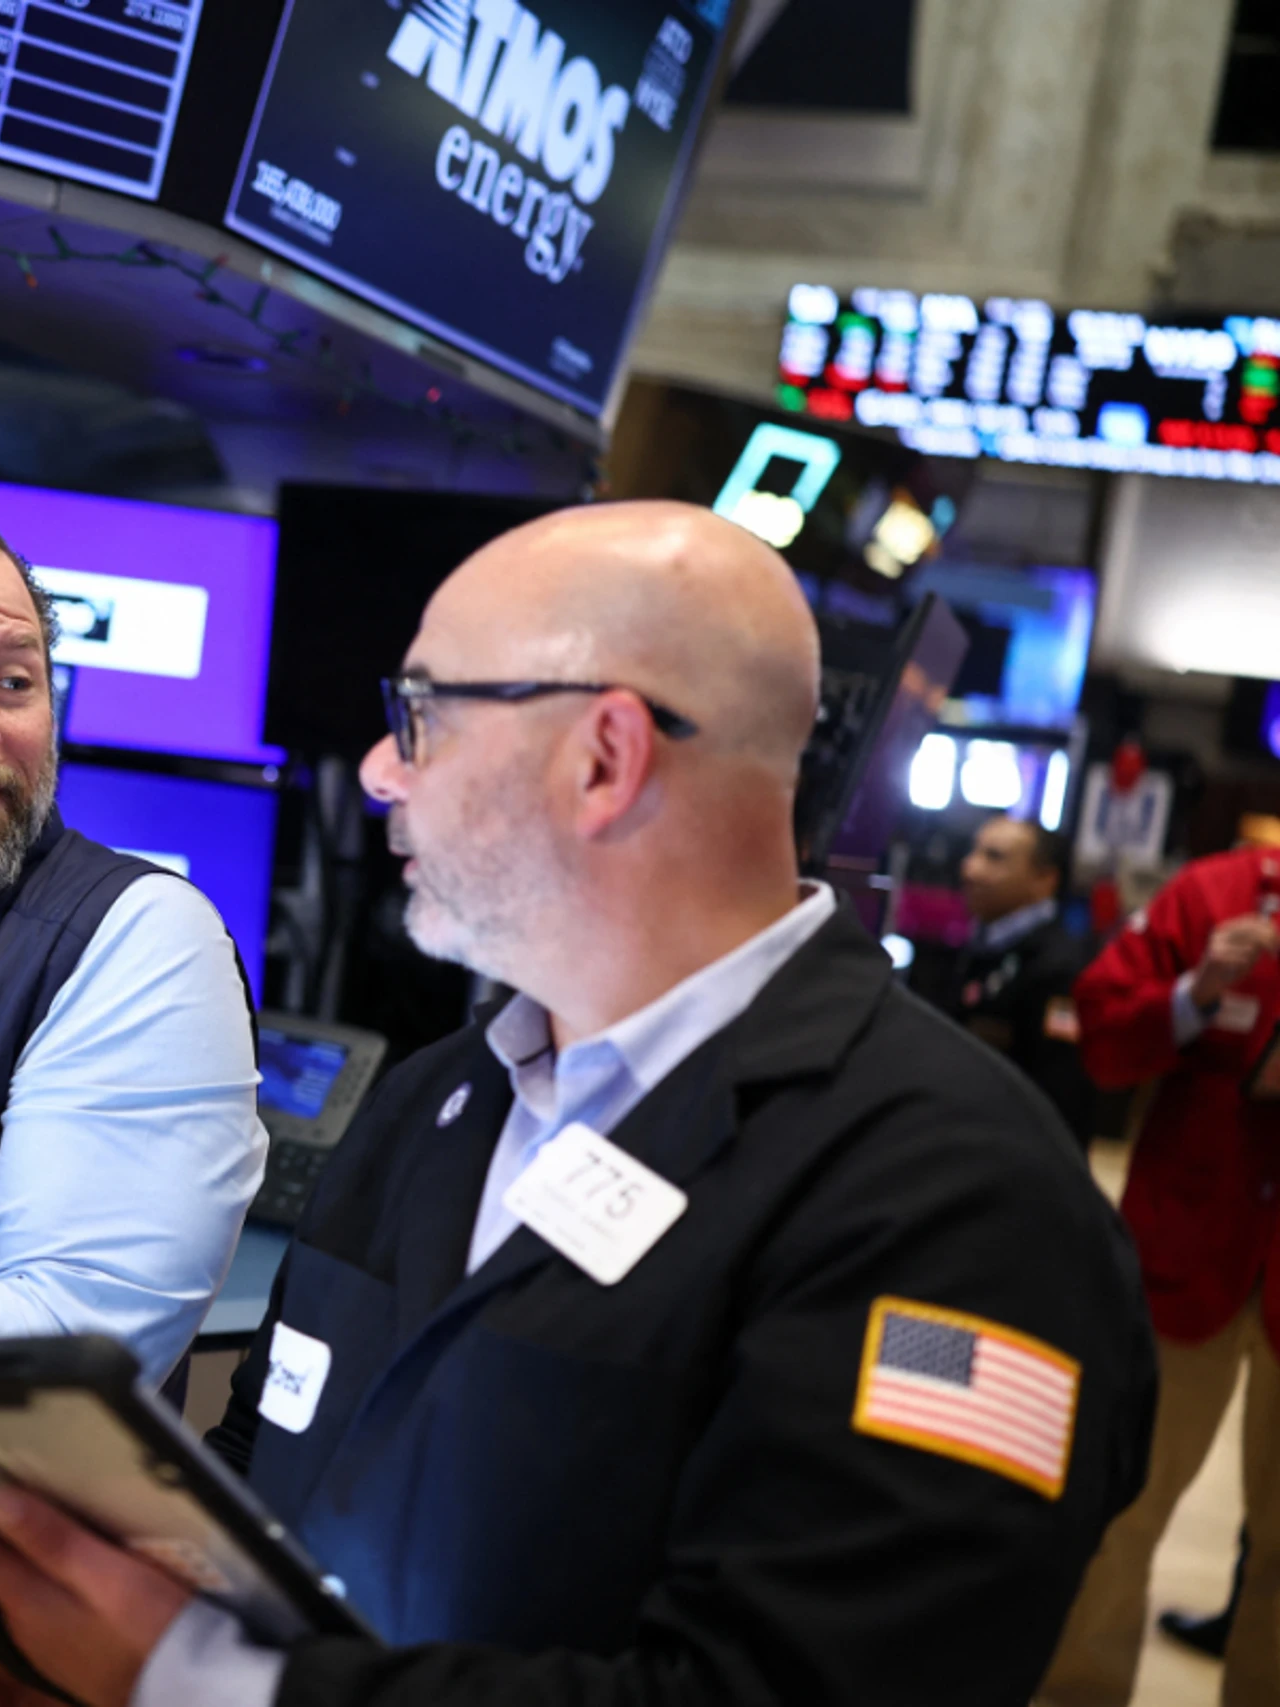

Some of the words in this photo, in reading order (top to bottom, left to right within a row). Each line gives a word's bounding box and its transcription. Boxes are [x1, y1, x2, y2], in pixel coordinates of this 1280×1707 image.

[387, 0, 631, 205] ATMOS
[435, 123, 595, 284] energy
[565, 1150, 645, 1220] 775
